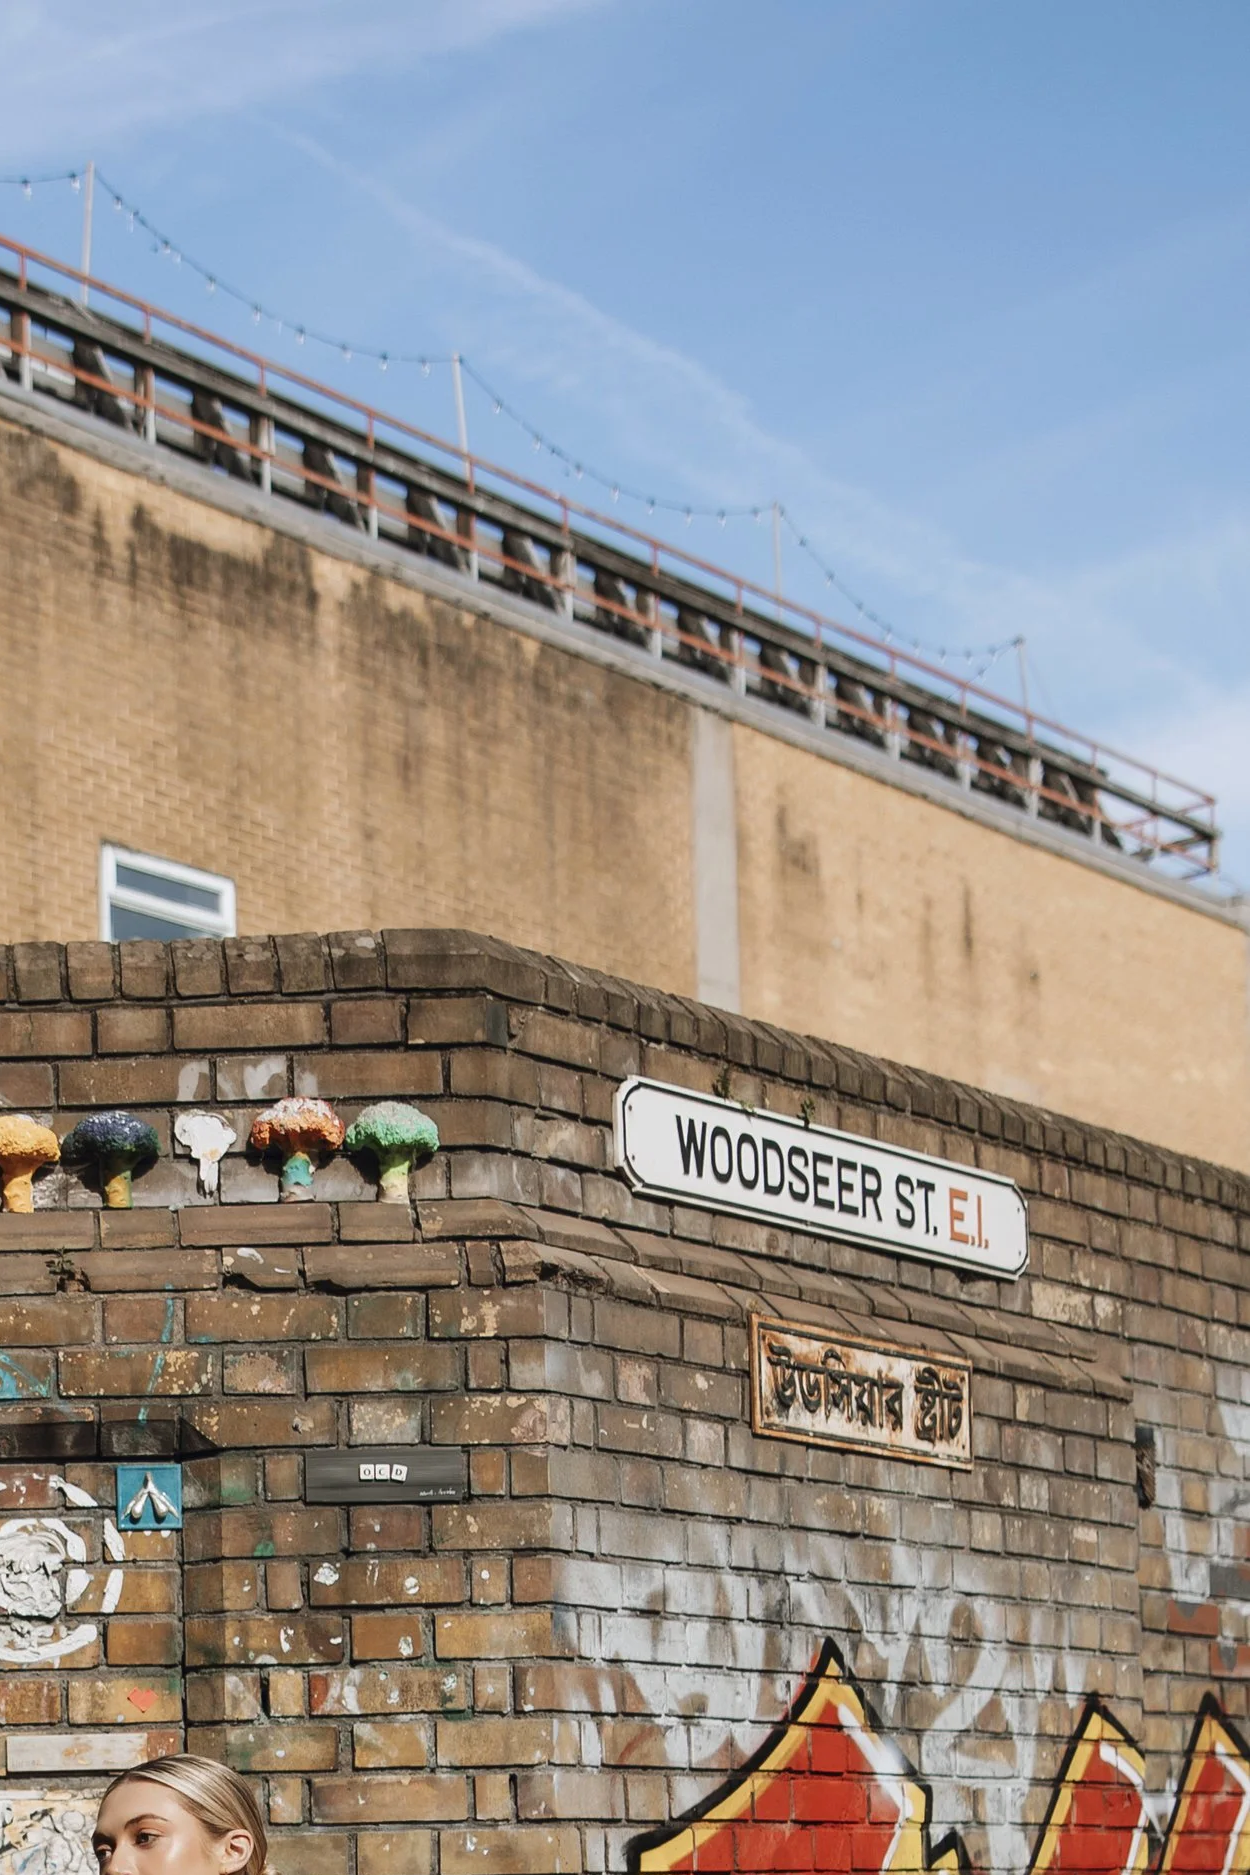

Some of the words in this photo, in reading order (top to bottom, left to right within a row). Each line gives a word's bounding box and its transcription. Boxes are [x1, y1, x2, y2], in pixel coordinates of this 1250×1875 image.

[675, 1114, 883, 1222] WOODSEER
[895, 1173, 938, 1236] ST.
[361, 1466, 404, 1479] OCD
